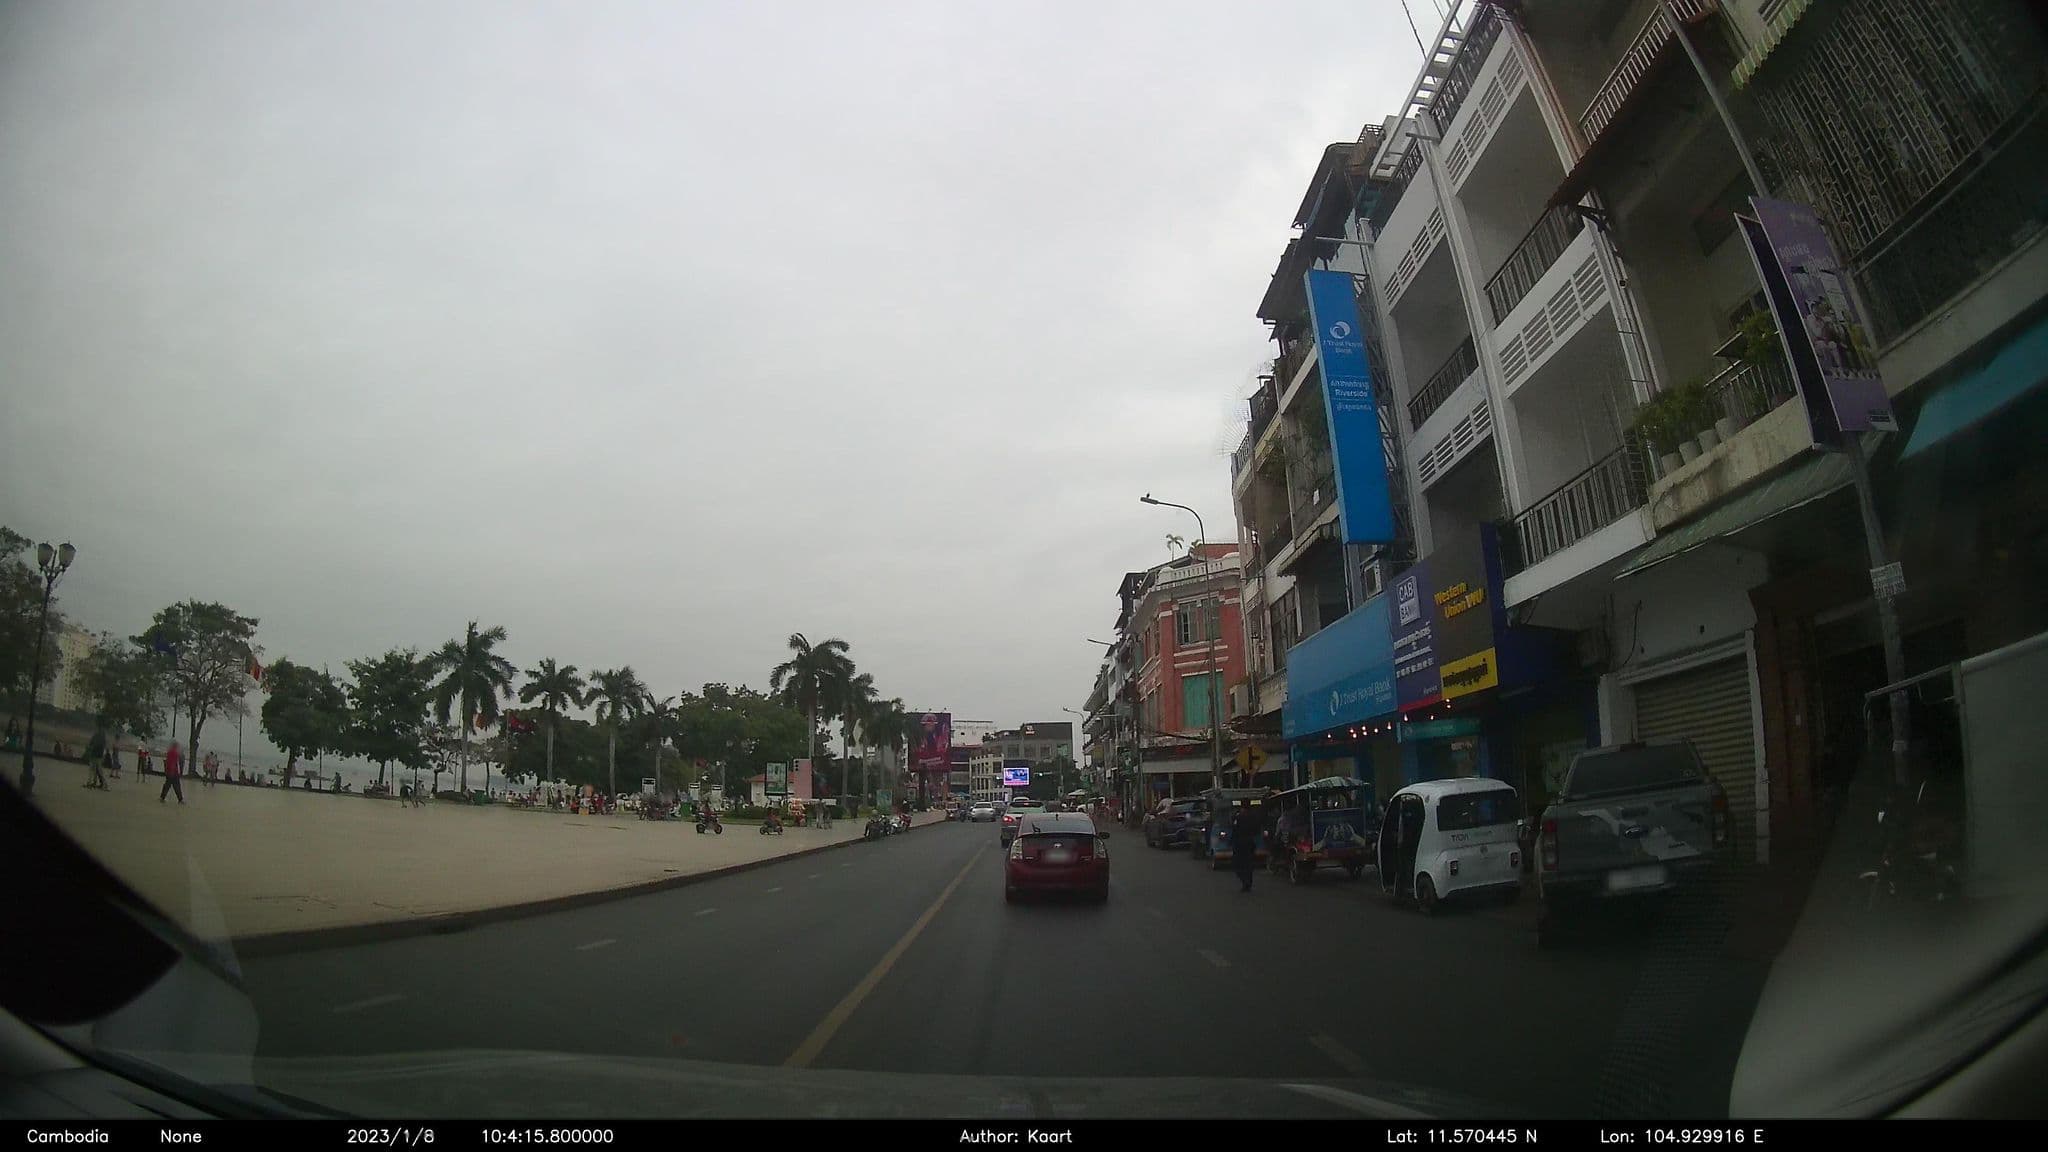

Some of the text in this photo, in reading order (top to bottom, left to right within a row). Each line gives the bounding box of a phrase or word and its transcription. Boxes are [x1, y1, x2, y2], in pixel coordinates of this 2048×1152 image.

[1399, 581, 1415, 602] CAB
[1434, 583, 1468, 603] Western
[1444, 600, 1467, 619] Union
[1374, 678, 1391, 694] Bank
